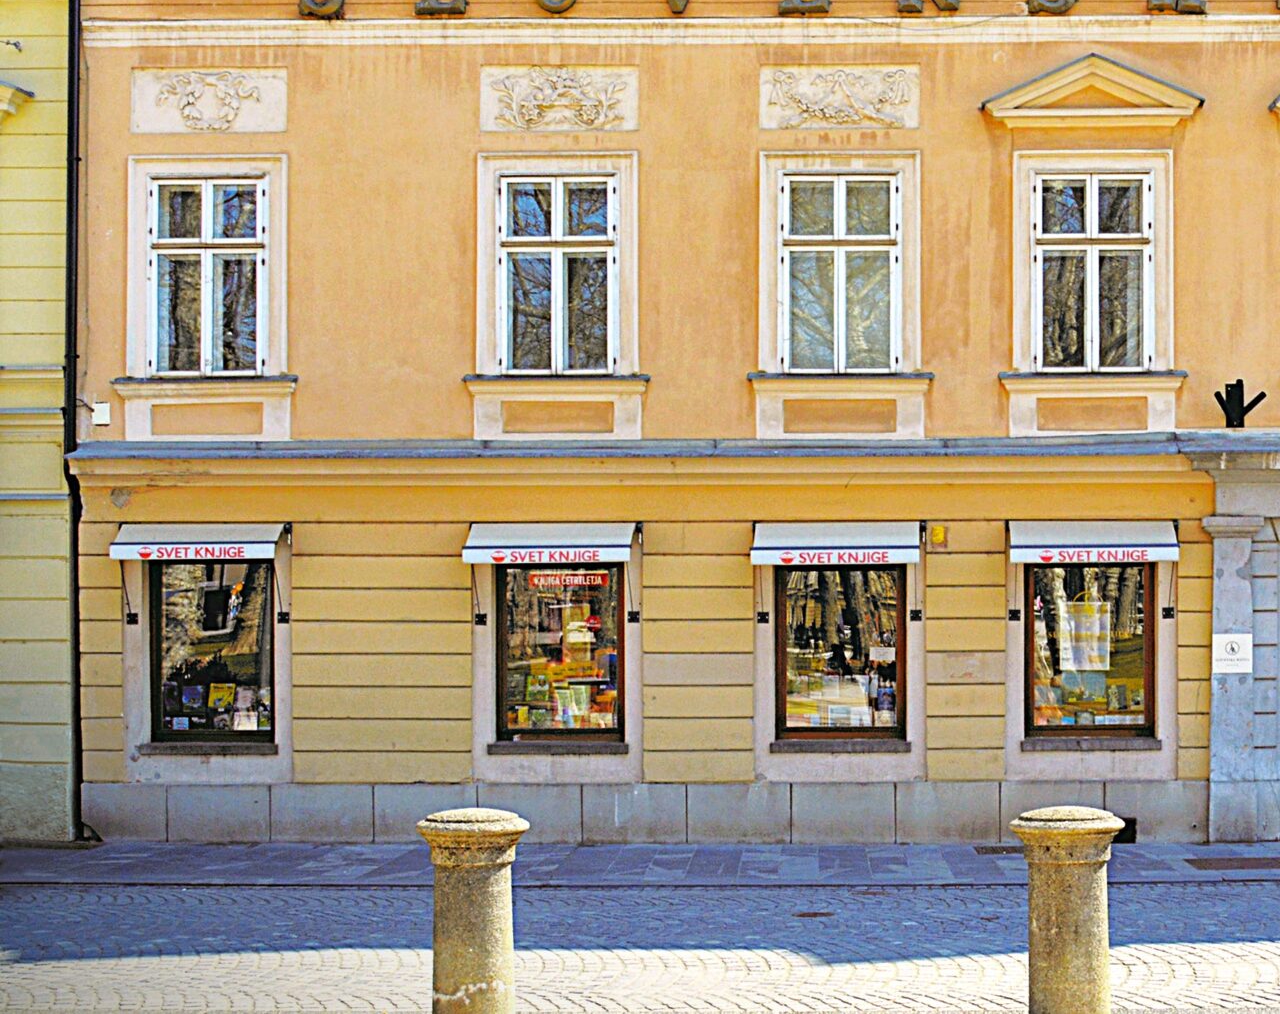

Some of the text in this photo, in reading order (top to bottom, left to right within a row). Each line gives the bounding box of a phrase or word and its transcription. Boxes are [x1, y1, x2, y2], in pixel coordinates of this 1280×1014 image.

[156, 546, 246, 559] SVET KNJIGE
[509, 550, 600, 563] SVET KNJIGE
[798, 551, 890, 564] SVET KNJIGE
[1057, 549, 1149, 562] SVET KNJIGE
